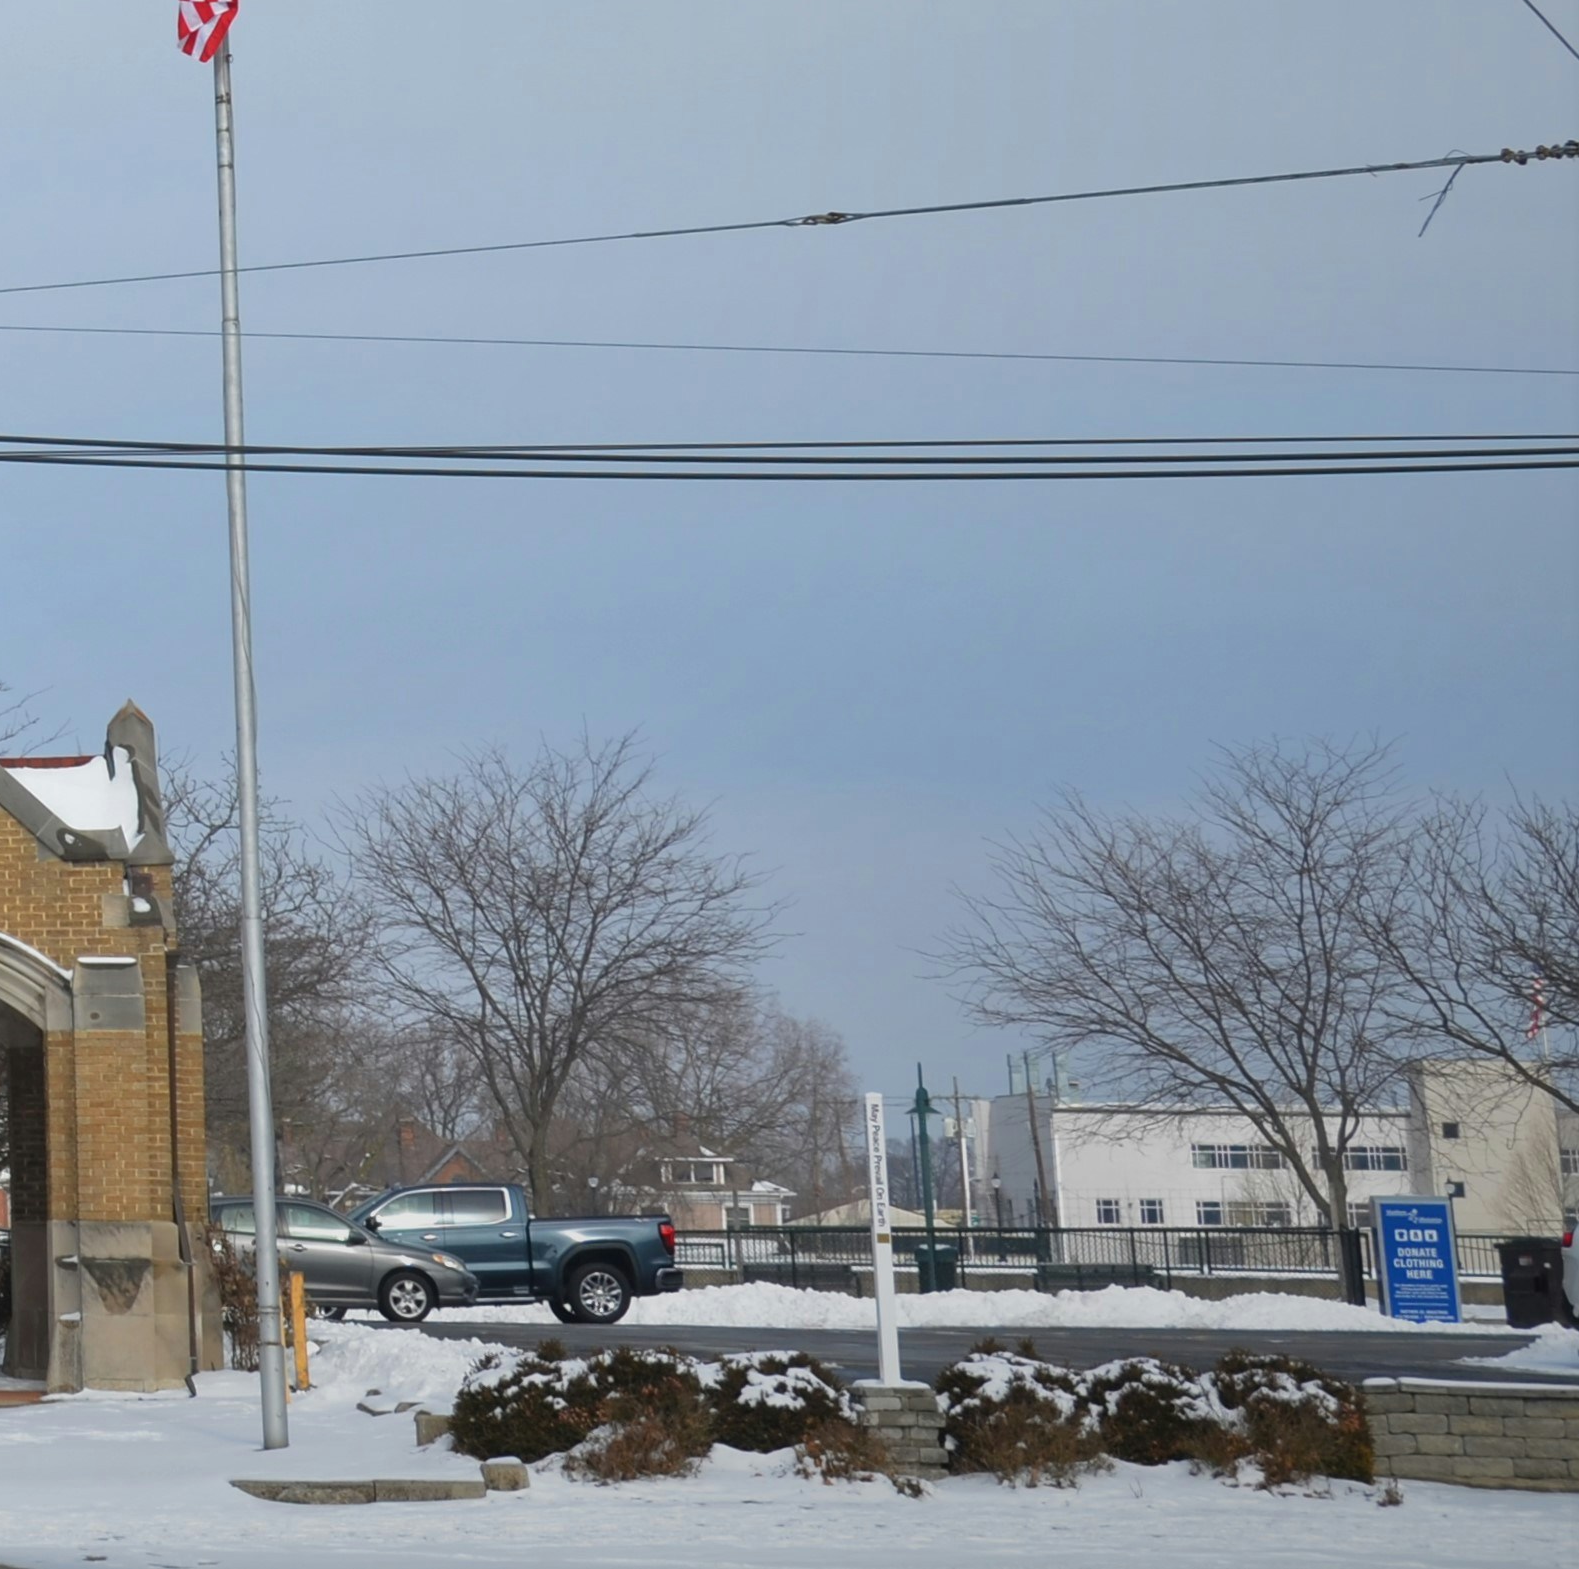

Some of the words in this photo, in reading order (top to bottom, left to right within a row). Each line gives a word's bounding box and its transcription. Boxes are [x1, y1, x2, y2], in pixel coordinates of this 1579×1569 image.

[870, 1103, 879, 1123] May
[872, 1125, 881, 1153] Peace
[874, 1155, 883, 1185] Prevail
[876, 1187, 885, 1200] On
[877, 1203, 886, 1227] Earth
[1397, 1247, 1437, 1258] DONATE
[1393, 1258, 1444, 1269] CLOTHING
[1406, 1269, 1433, 1280] HERE
